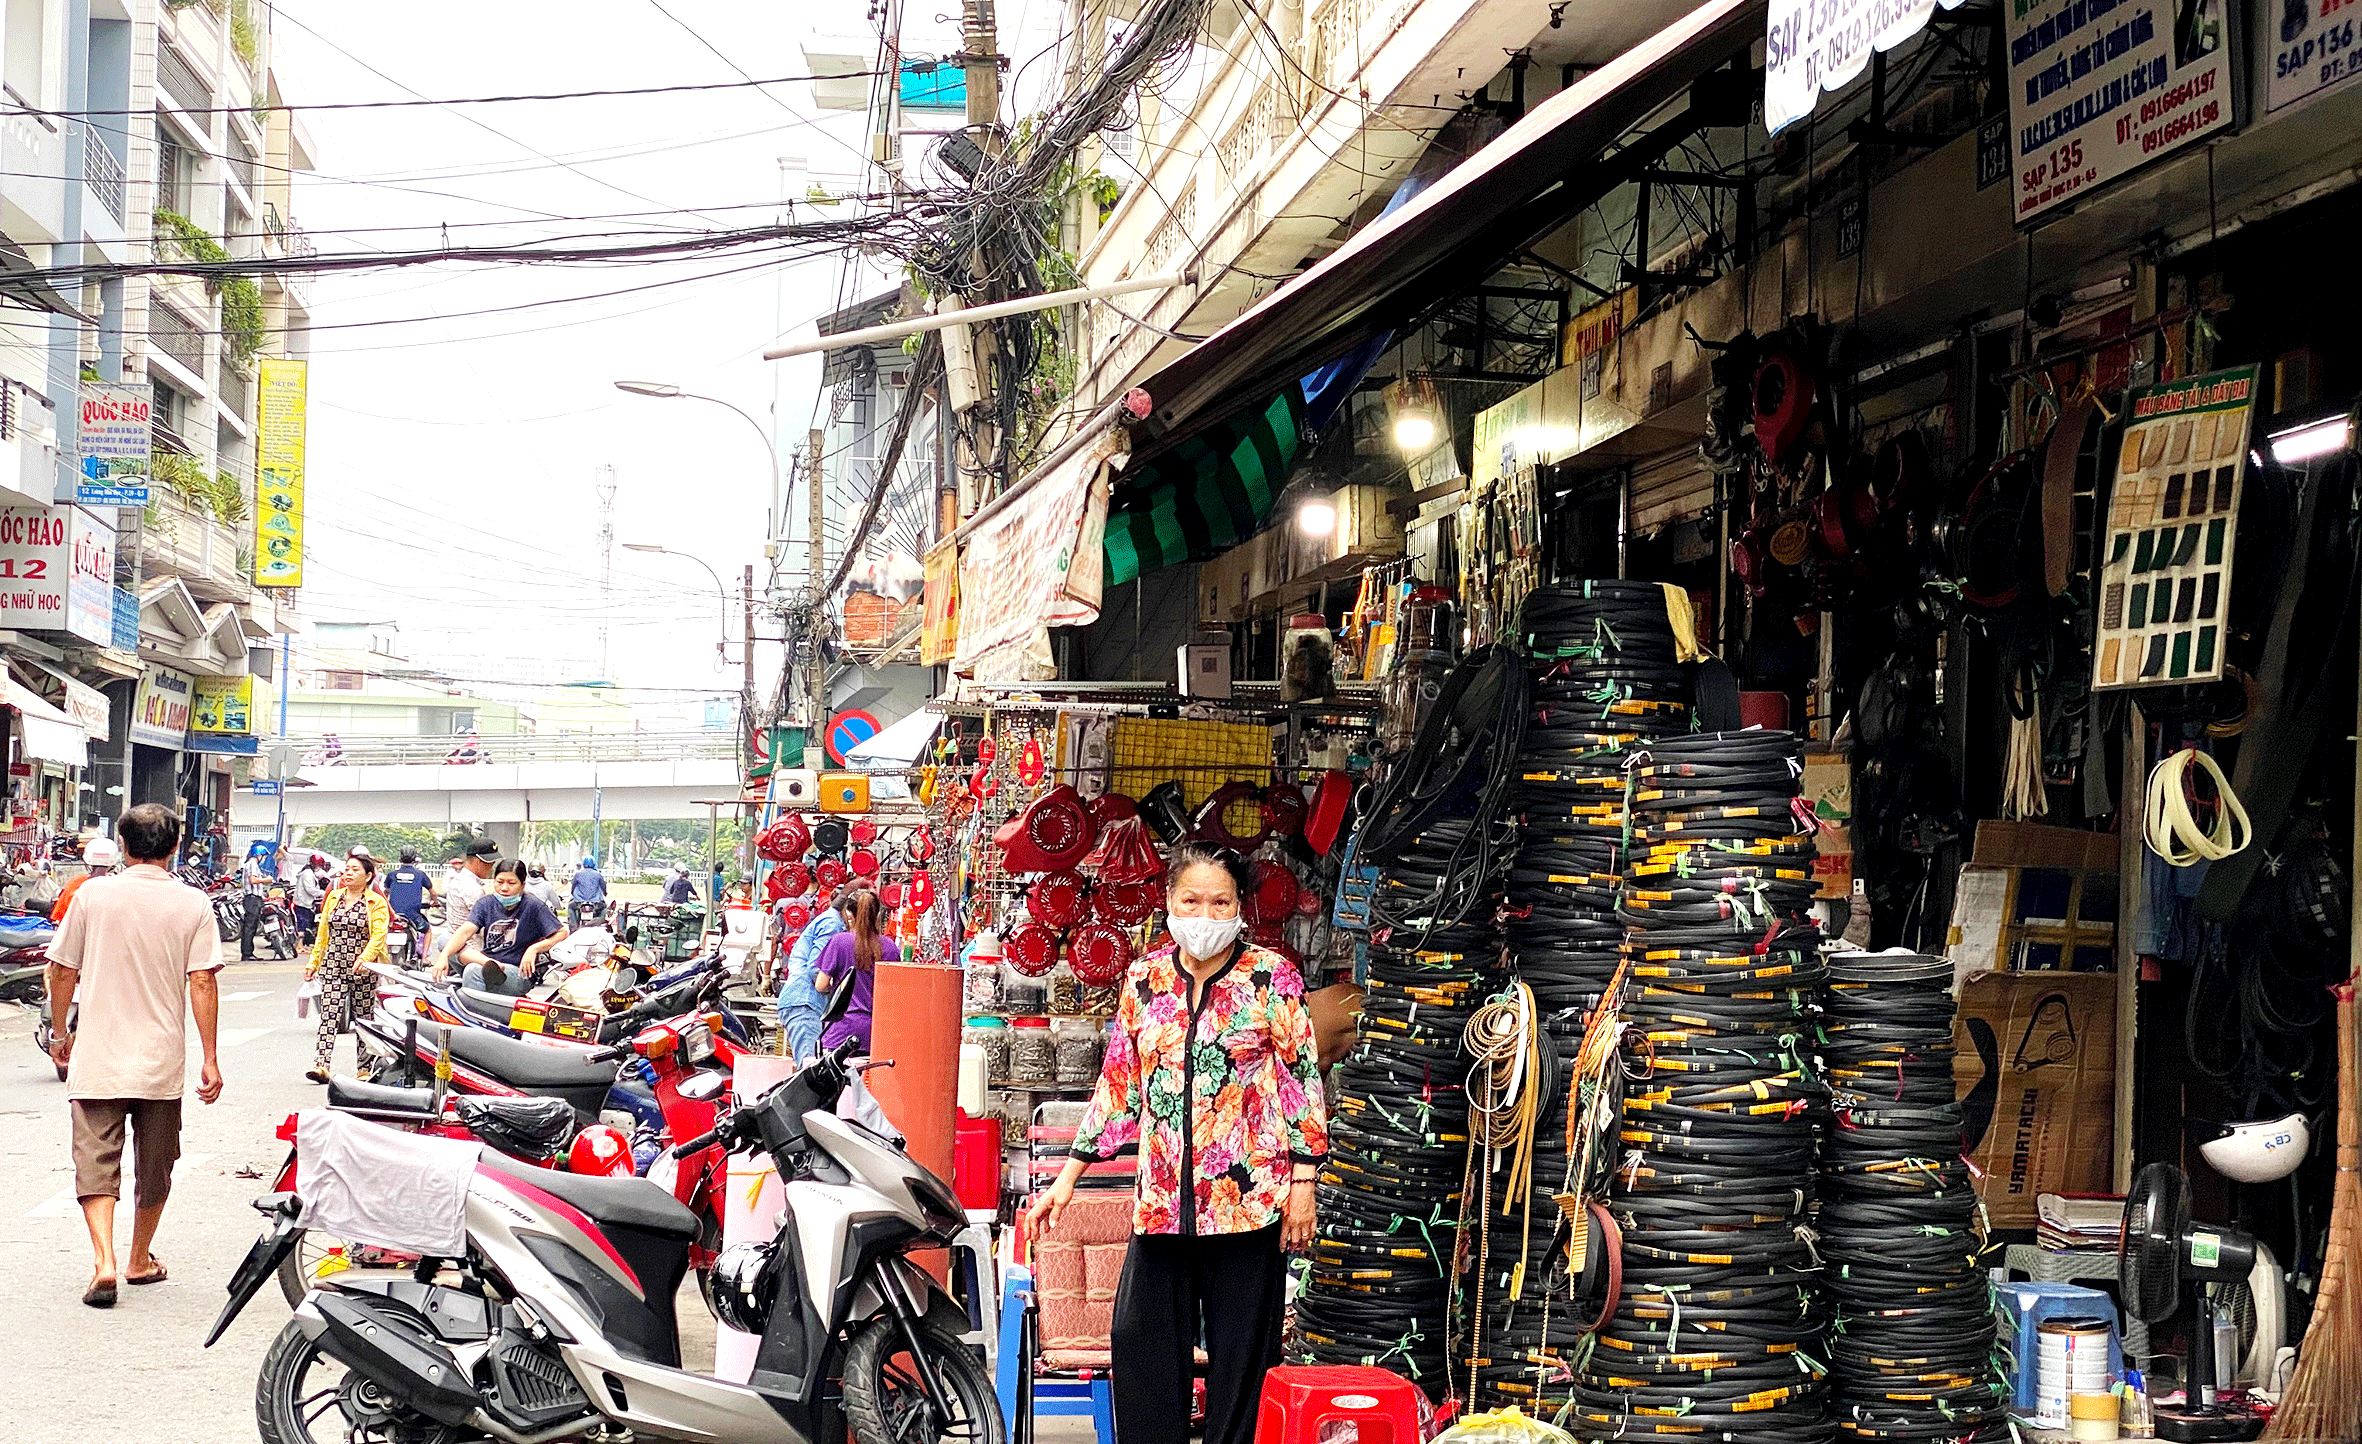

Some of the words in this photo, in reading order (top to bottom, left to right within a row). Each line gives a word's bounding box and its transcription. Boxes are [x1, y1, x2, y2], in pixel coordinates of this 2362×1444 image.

[2276, 40, 2315, 78] SẠP
[2318, 19, 2353, 59] 136
[2140, 68, 2216, 124] 0916664197
[2142, 100, 2219, 153] 0916664198
[2022, 163, 2047, 192] SẠP
[2050, 137, 2083, 180] 135
[83, 392, 118, 425] QUỐC
[121, 397, 148, 421] HÀO
[2201, 386, 2210, 406] &
[27, 509, 64, 546] HÀO
[0, 558, 47, 579] 12
[11, 588, 35, 610] NHỮ
[38, 594, 61, 614] HỌC
